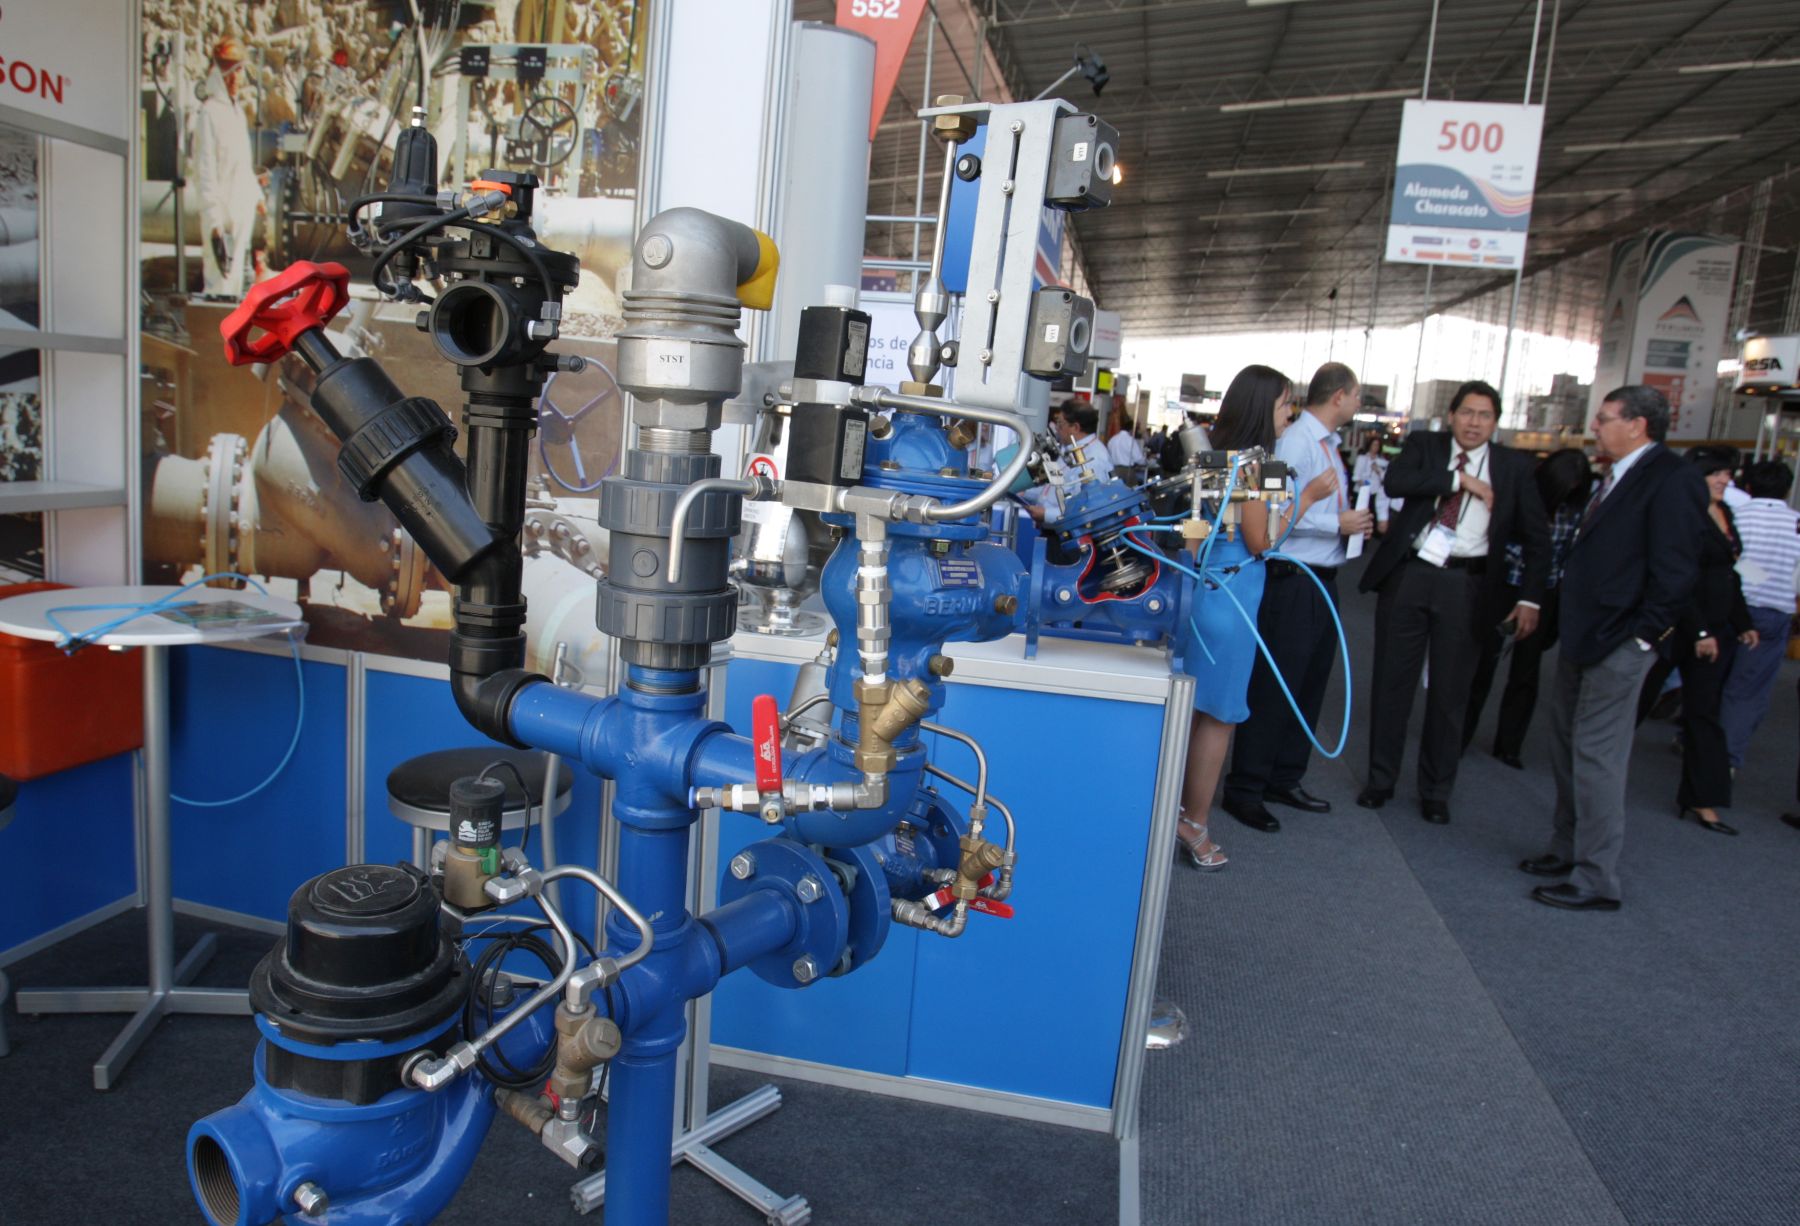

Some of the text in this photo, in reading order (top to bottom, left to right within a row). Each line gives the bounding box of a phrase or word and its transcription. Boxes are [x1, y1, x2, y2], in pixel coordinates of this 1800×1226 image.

[851, 0, 900, 19] 552
[1437, 120, 1504, 152] 500
[1404, 182, 1469, 200] Alameda
[1415, 200, 1488, 217] Characato
[890, 336, 907, 349] de
[659, 354, 684, 363] STST
